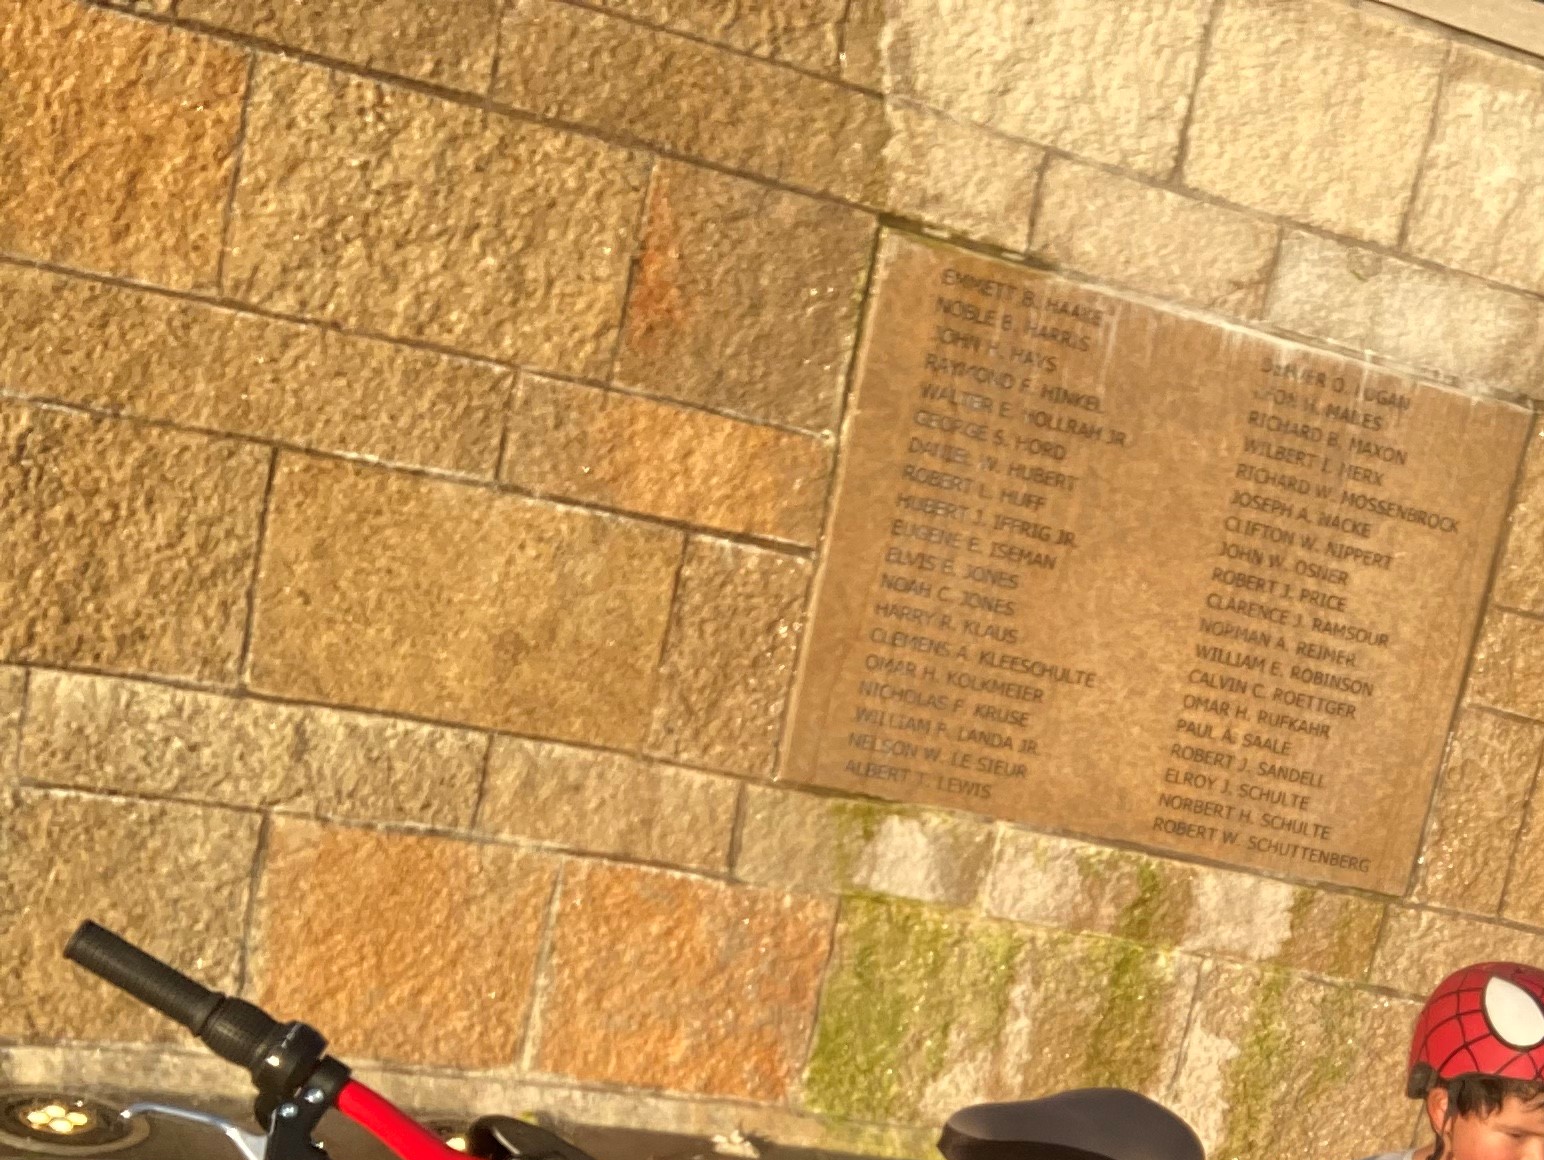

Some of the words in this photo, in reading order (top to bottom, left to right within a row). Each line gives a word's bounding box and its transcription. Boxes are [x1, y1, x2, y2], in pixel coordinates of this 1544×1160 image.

[914, 408, 987, 440] GEORGE
[1248, 411, 1322, 443] RICHARD
[1349, 438, 1406, 465] MAXON
[1243, 437, 1317, 468] WILBERT
[903, 464, 971, 494] ROBERT
[1000, 488, 1045, 512] HUFF
[1008, 461, 1077, 491] HUBERT
[897, 491, 968, 521] HUBERT
[1231, 490, 1292, 518] JOSEPH
[1236, 464, 1310, 494] RICHARD
[1341, 491, 1459, 533] MOSSENBROCK
[891, 519, 961, 548] EUGENE
[1224, 516, 1294, 545] CLIFTON
[1326, 542, 1391, 569] NIPPERT
[886, 546, 935, 571] ELVIS
[964, 564, 1018, 589] JONES
[1220, 542, 1263, 565] JOHN
[1295, 560, 1348, 585] OSNER
[881, 573, 931, 596] NOAH
[960, 591, 1014, 615] JONES
[1206, 593, 1288, 624] CLARENCE
[1212, 568, 1276, 594] ROBERT
[1300, 589, 1346, 611] PRICE
[870, 627, 950, 657] CLEMENS
[875, 600, 933, 625] HARRY
[963, 620, 1018, 644] KLAUS
[1200, 618, 1271, 646] NORMAN
[1296, 641, 1357, 666] REIMER
[865, 653, 916, 677] OMAR
[947, 671, 1043, 703] KOLKMEIER
[1195, 644, 1265, 671] WILLIAM
[1290, 665, 1373, 696] ROBINSON
[859, 680, 947, 710] NICHOLAS
[973, 704, 1029, 727] KRUSE
[1188, 669, 1247, 694] CALVIN
[1273, 688, 1357, 718] ROETTGER
[855, 706, 930, 734] WILLIAM
[1176, 719, 1215, 739] PAUL
[1242, 733, 1291, 755] SAALE
[1183, 695, 1229, 716] OMAR
[1235, 706, 1251, 720] H.
[1257, 711, 1330, 737] RUFKAHR
[849, 732, 917, 758] NELSON
[951, 752, 973, 769] LE
[976, 757, 1027, 779] SIEUR
[1170, 744, 1234, 769] ROBERT
[1237, 758, 1251, 772] J.
[1258, 762, 1324, 787] SANDELL
[846, 758, 911, 783] ALBERT
[937, 776, 992, 798] LEWIS
[1165, 769, 1217, 791] ELROY
[1239, 784, 1309, 809] SCHULTE
[1159, 794, 1234, 820] NORBERT
[1239, 810, 1255, 824] H.
[1260, 814, 1331, 839] SCHULTE
[1153, 818, 1217, 842] ROBERT
[1247, 836, 1370, 871] SCHUTTENBERG
